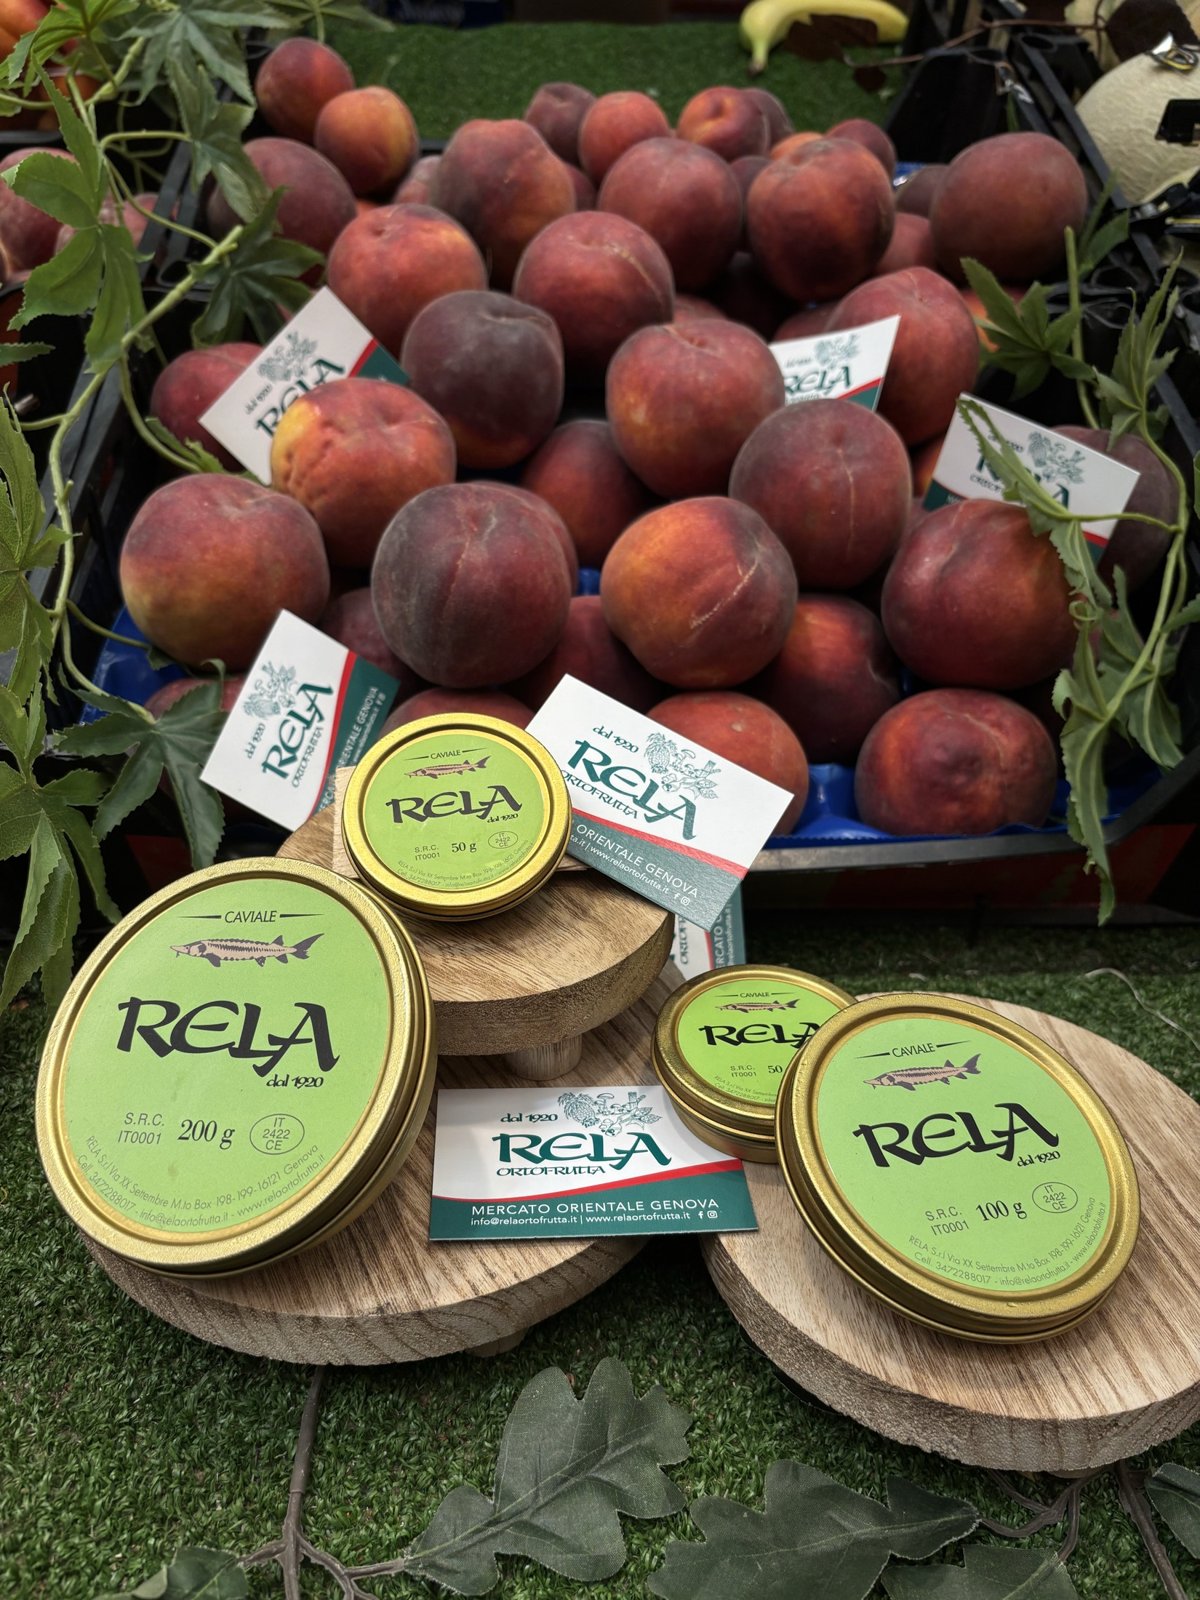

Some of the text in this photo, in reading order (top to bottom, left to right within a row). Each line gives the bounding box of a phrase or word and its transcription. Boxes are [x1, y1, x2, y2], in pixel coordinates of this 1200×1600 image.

[261, 683, 334, 779] RELA
[592, 725, 640, 754] dal 1920
[430, 749, 461, 760] CAVIALE
[567, 740, 697, 840] RELA
[385, 785, 522, 823] RELA
[451, 842, 477, 853] 50 g
[414, 852, 441, 861] IT0001
[576, 824, 644, 866] ORIENTALE
[645, 862, 699, 898] GENOVA
[589, 845, 669, 895] www.relaortofrutta.it
[224, 910, 277, 923] CAVIALE
[117, 996, 340, 1078] RELA
[698, 1022, 821, 1049] RELA
[892, 1042, 936, 1058] CAVIALE
[767, 1065, 783, 1074] 50
[266, 1074, 324, 1090] dal 1920
[124, 1112, 165, 1126] S.R.C.
[273, 1117, 285, 1128] IT
[500, 1113, 559, 1123] dal 1920
[118, 1130, 162, 1145] IT0001
[178, 1119, 236, 1150] 200 g
[262, 1128, 291, 1139] 2422
[852, 1102, 1059, 1167] RELA
[265, 1139, 283, 1151] CE
[492, 1132, 672, 1170] RELA
[1017, 1150, 1061, 1168] dal 1920
[87, 1135, 102, 1158] RELA
[130, 1183, 169, 1208] Settembre
[194, 1199, 212, 1210] Box
[283, 1144, 318, 1175] Genova
[496, 1165, 606, 1177] ORTOFRUTTA
[1044, 1184, 1054, 1194] IT
[1042, 1191, 1067, 1204] 2422
[1051, 1200, 1068, 1211] CE
[472, 1198, 719, 1216] MERCATO ORIENTALE GENOVA
[925, 1206, 962, 1221] S.R.C.
[976, 1200, 1028, 1221] 100 g
[471, 1214, 578, 1226] info@relaortofrutta.it
[585, 1211, 691, 1223] www.relaortofrutta.it
[930, 1219, 970, 1236] IT0001
[908, 1235, 929, 1252] RELA
